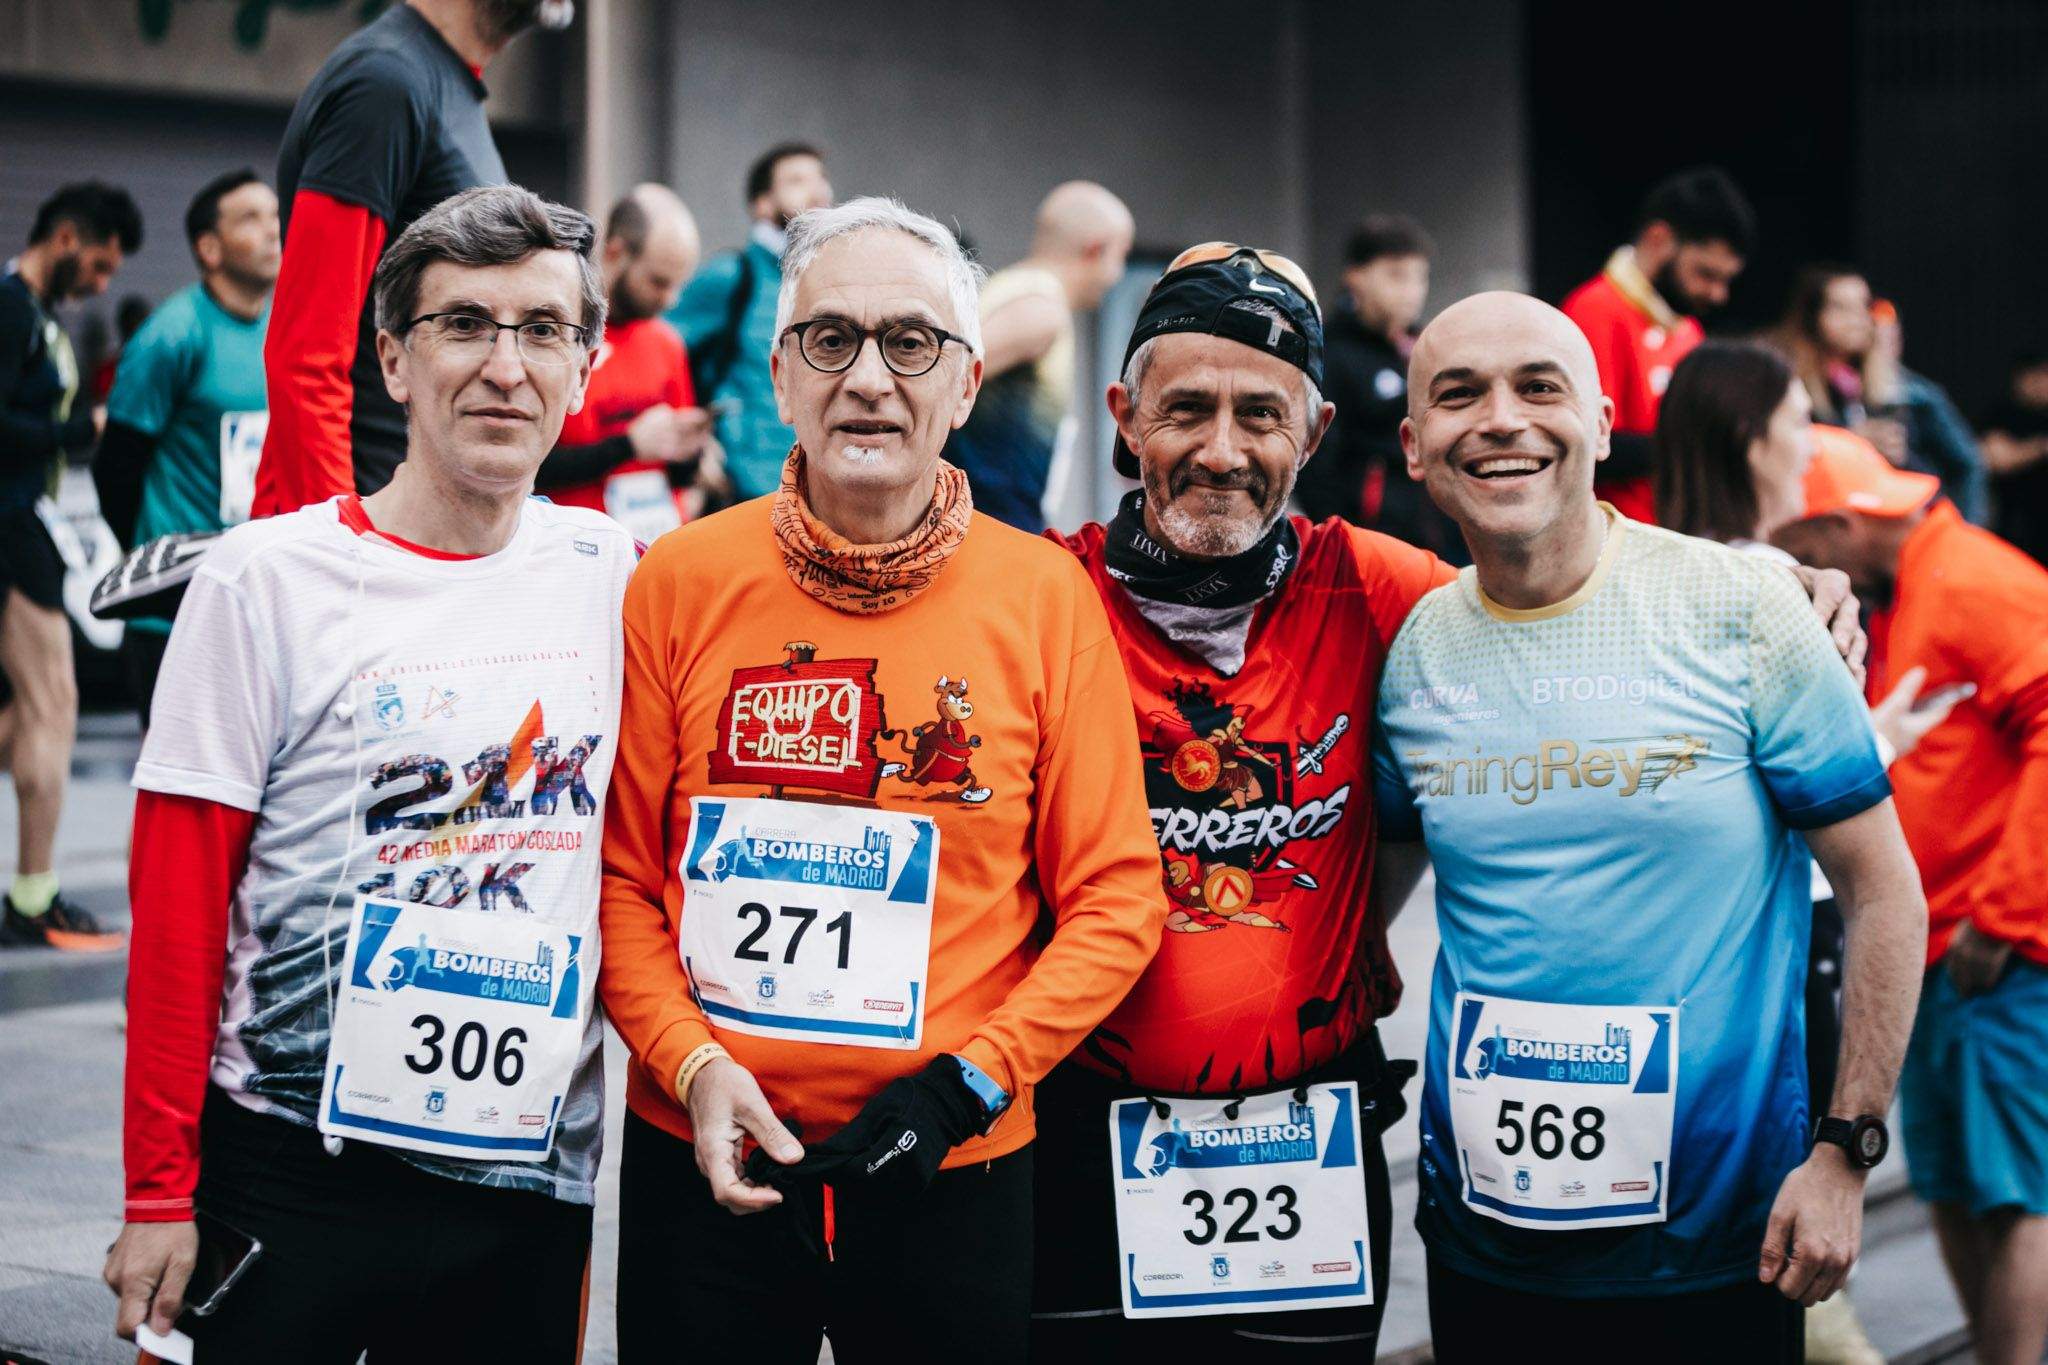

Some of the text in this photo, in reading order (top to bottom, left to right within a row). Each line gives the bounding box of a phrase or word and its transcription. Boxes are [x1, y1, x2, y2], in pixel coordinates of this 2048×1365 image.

[1157, 316, 1197, 328] DRI-FIT
[1410, 682, 1479, 709] CURVA
[1532, 672, 1699, 706] BTODigital
[733, 684, 858, 726] EQUIPO
[378, 844, 398, 864] 42
[401, 838, 451, 863] MEDIA
[527, 830, 583, 852] COSLADA
[753, 839, 885, 869] BOMBEROS
[802, 862, 884, 889] de MADRID
[734, 902, 852, 969] 271
[433, 950, 550, 984] BOMBEROS
[480, 978, 550, 1004] de MADRID
[404, 1014, 528, 1086] 306
[1506, 1039, 1628, 1063] BOMBEROS
[1549, 1064, 1627, 1081] de MADRID
[1190, 1124, 1312, 1148] BOMBEROS
[1495, 1099, 1606, 1161] 568
[1239, 1141, 1313, 1163] de MADRID
[1182, 1184, 1302, 1245] 323
